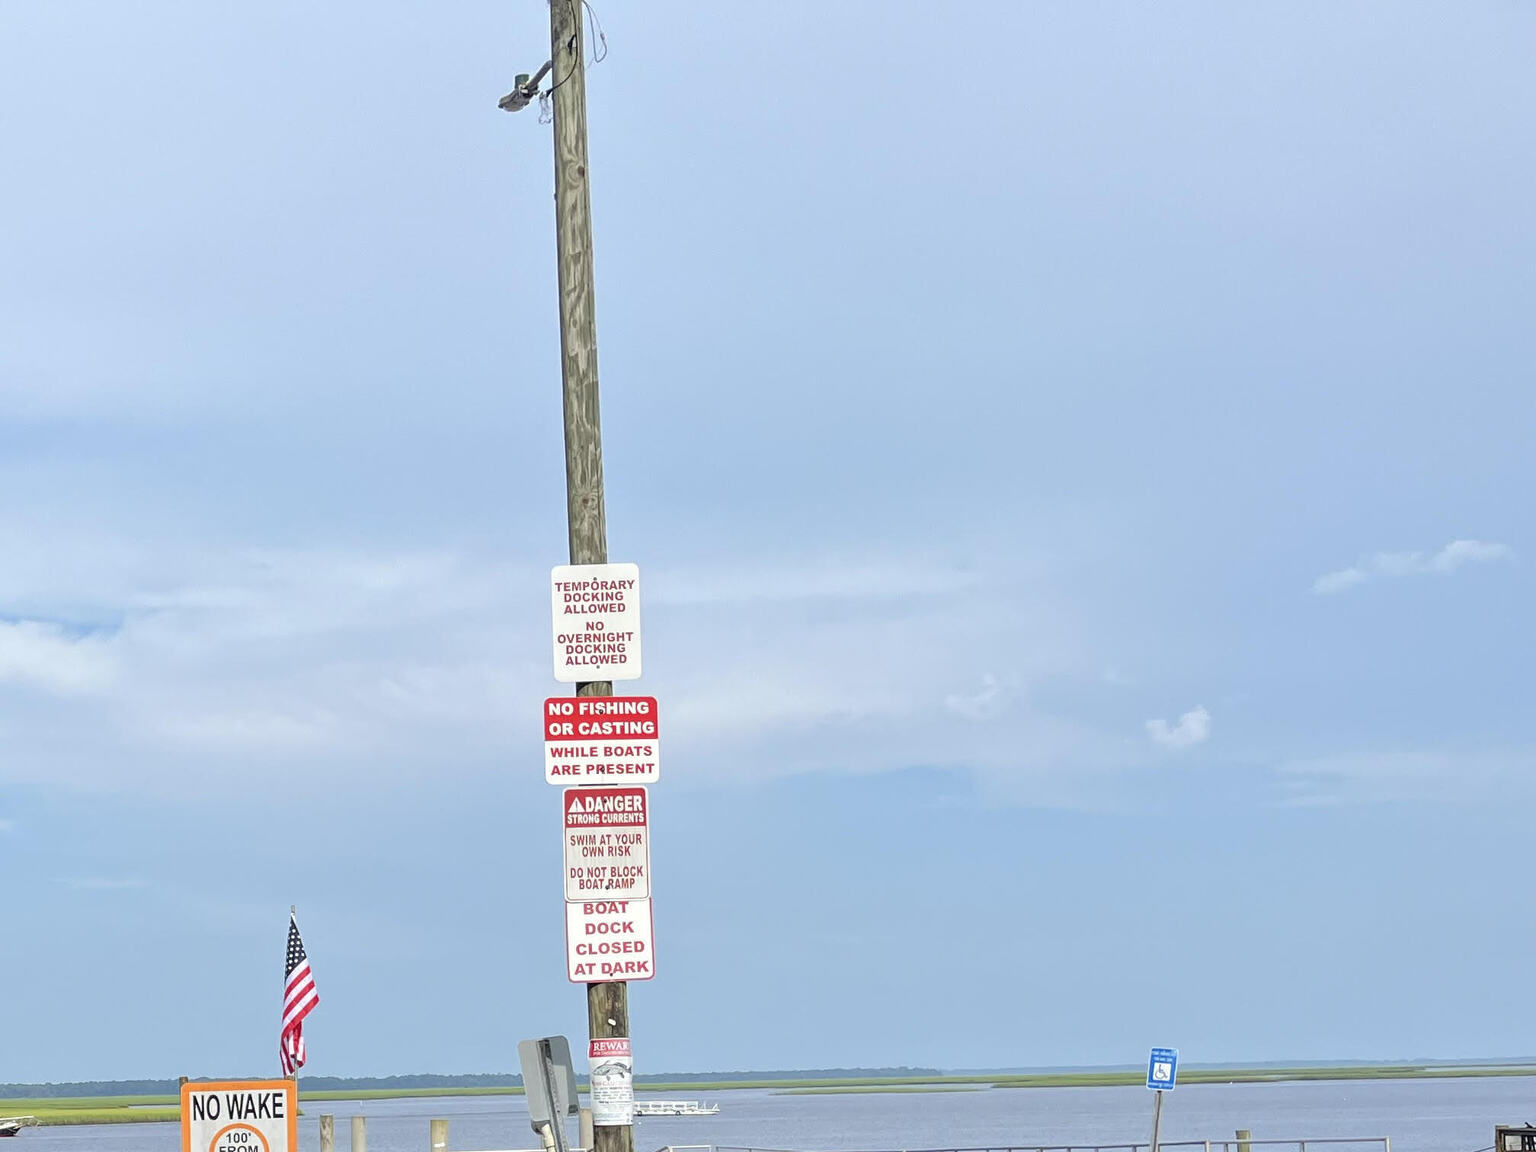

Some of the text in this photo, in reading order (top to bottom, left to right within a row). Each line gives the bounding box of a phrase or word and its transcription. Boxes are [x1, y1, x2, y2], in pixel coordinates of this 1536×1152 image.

[555, 580, 635, 592] TEMPORARY
[564, 592, 624, 602] DOCKING
[564, 603, 626, 614] ALLOWED
[586, 621, 604, 631] NO
[557, 632, 634, 643] OVERNIGHT
[566, 643, 626, 654] DOCKING
[566, 654, 627, 665] ALLOWED
[548, 702, 649, 716] NO FISHING
[548, 721, 655, 735] OR CASTING
[550, 746, 652, 757] WHILE BOATS
[551, 763, 655, 776] ARE PRESENT
[585, 795, 643, 812] DANGER
[567, 812, 645, 825] STRONG CURRENTS
[570, 833, 642, 846] SWIM AT YOUR
[582, 845, 631, 857] OWN RISK
[570, 866, 643, 878] DO NOT BLOCK
[579, 878, 635, 890] BOAT RAMP
[583, 901, 629, 915] BOAT
[585, 921, 634, 935] DOCK
[576, 941, 645, 955] CLOSED
[575, 960, 649, 975] AT DARK
[593, 1042, 629, 1051] REWAR
[192, 1093, 284, 1121] NO WAKE
[226, 1132, 252, 1144] 100'
